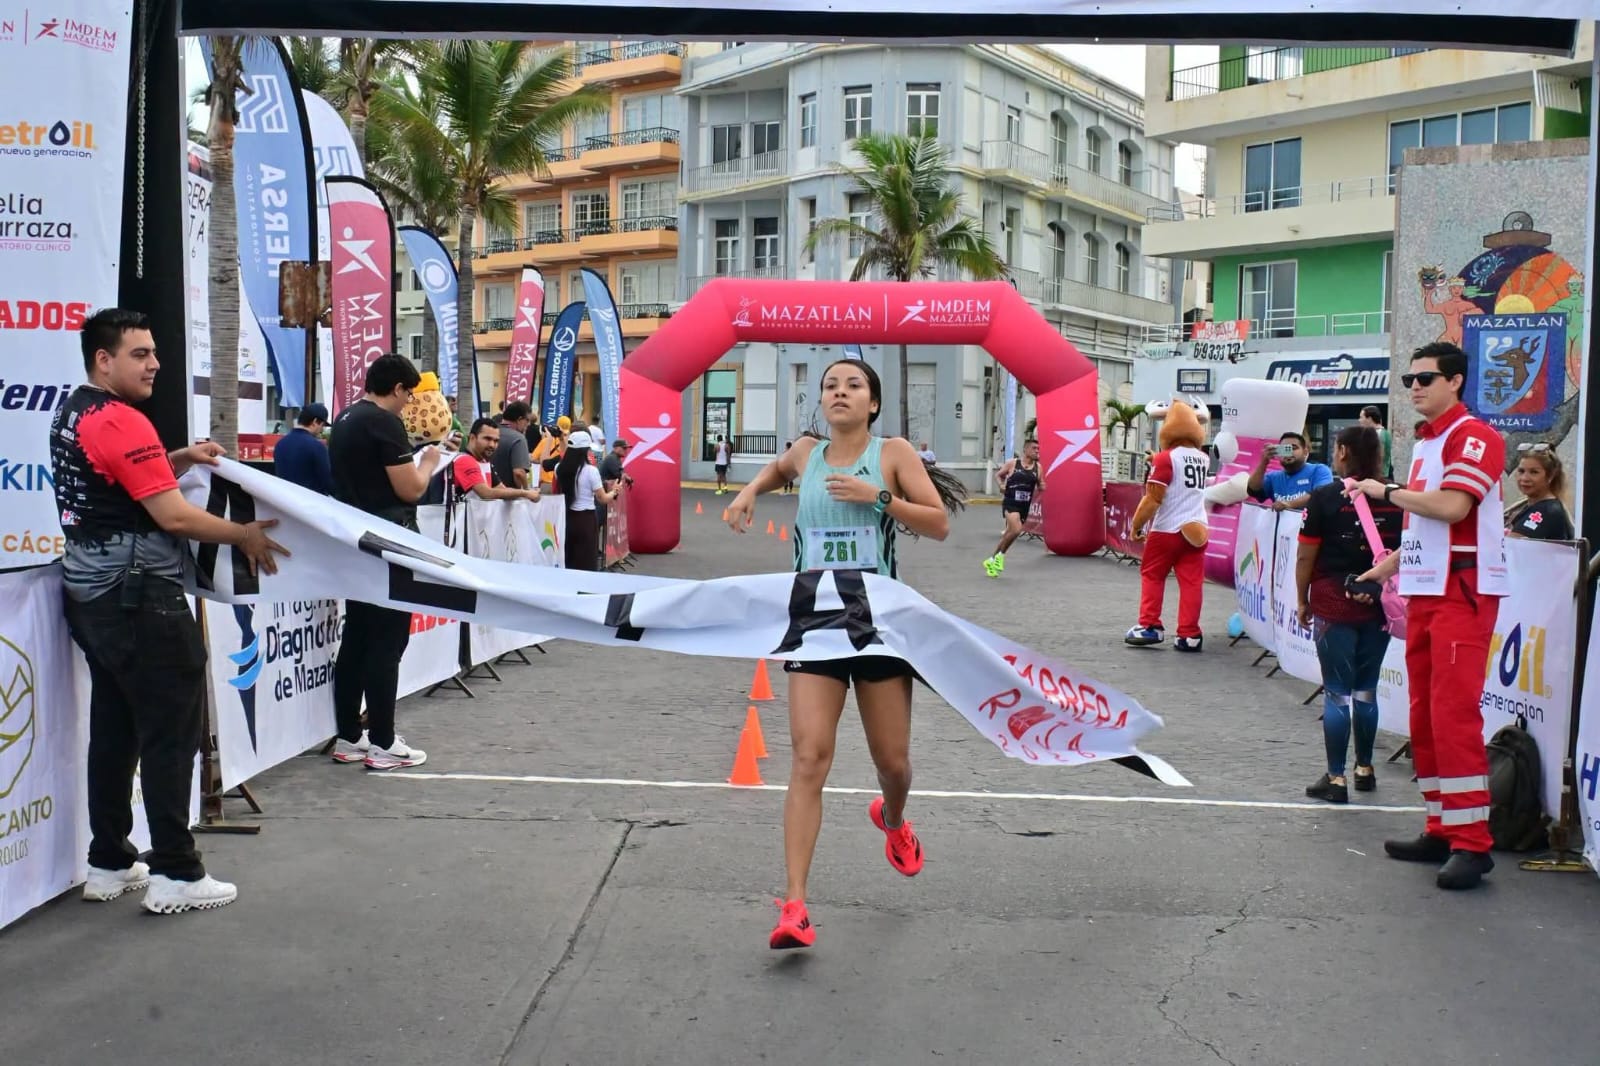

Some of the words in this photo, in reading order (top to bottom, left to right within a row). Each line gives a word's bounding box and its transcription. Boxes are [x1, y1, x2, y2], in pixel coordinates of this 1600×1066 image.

[64, 18, 117, 41] IMDEM
[761, 303, 872, 321] MAZATLÁN
[930, 299, 991, 313] IMDEM
[1467, 317, 1563, 329] MAZATLAN
[549, 351, 562, 396] CERRITOS
[547, 399, 558, 424] VILLA
[1489, 418, 1534, 426] MAZATL
[1184, 465, 1206, 489] 911
[823, 541, 857, 562] 261
[274, 669, 293, 702] de
